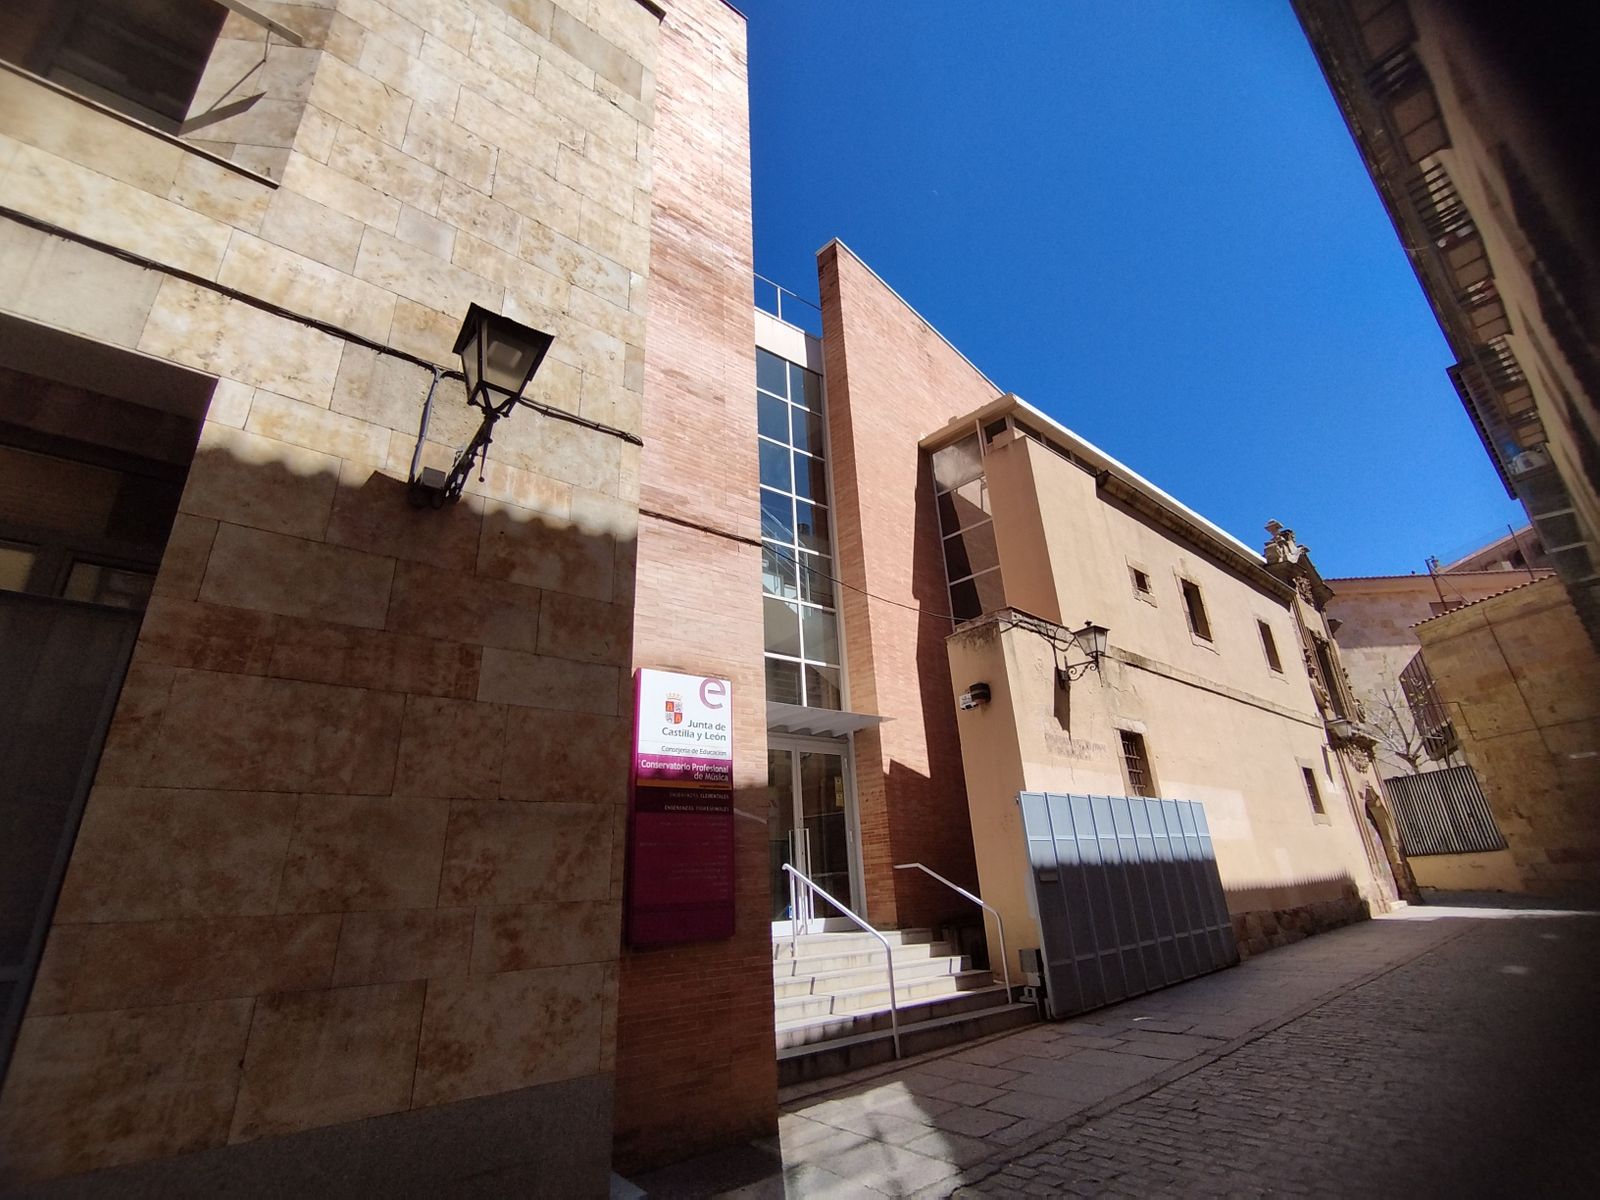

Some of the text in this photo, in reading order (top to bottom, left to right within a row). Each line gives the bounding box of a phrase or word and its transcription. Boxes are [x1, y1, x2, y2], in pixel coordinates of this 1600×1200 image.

[688, 720, 726, 731] Junta de
[662, 727, 726, 742] Castilla y León
[641, 760, 728, 773] Conservatorio Profesional
[694, 772, 728, 782] de Música
